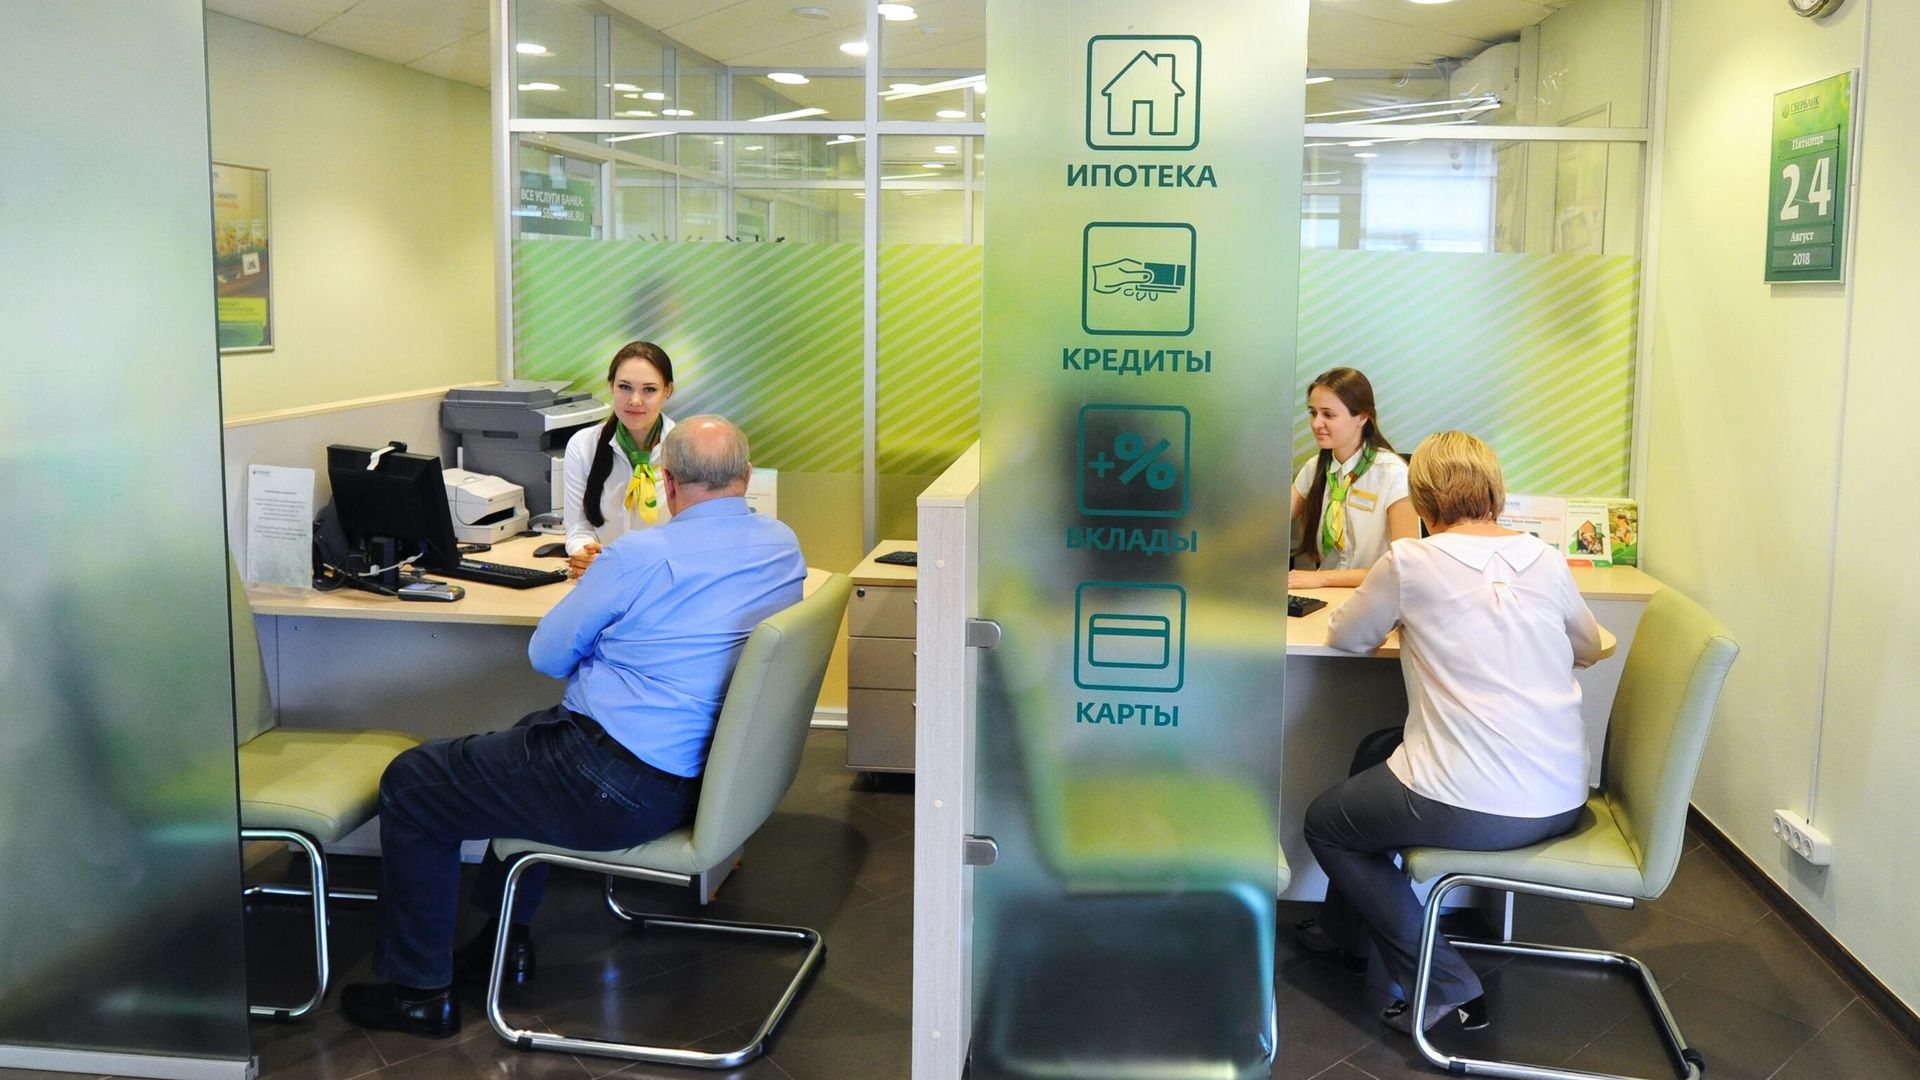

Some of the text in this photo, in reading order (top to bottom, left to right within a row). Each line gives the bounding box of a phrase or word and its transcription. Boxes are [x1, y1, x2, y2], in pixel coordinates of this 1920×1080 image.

[1792, 135, 1824, 151] Пятница
[1067, 164, 1218, 188] ИПОТЕКА
[521, 189, 534, 201] ВСЕ
[535, 191, 560, 204] УСЛУГИ
[1780, 157, 1831, 221] 24
[1790, 229, 1815, 244] Август
[1792, 252, 1811, 266] 2018
[1063, 347, 1212, 376] КРЕДИТЫ
[1066, 526, 1198, 557] ВКЛАДЫ
[1076, 702, 1179, 727] КАРТЫ
